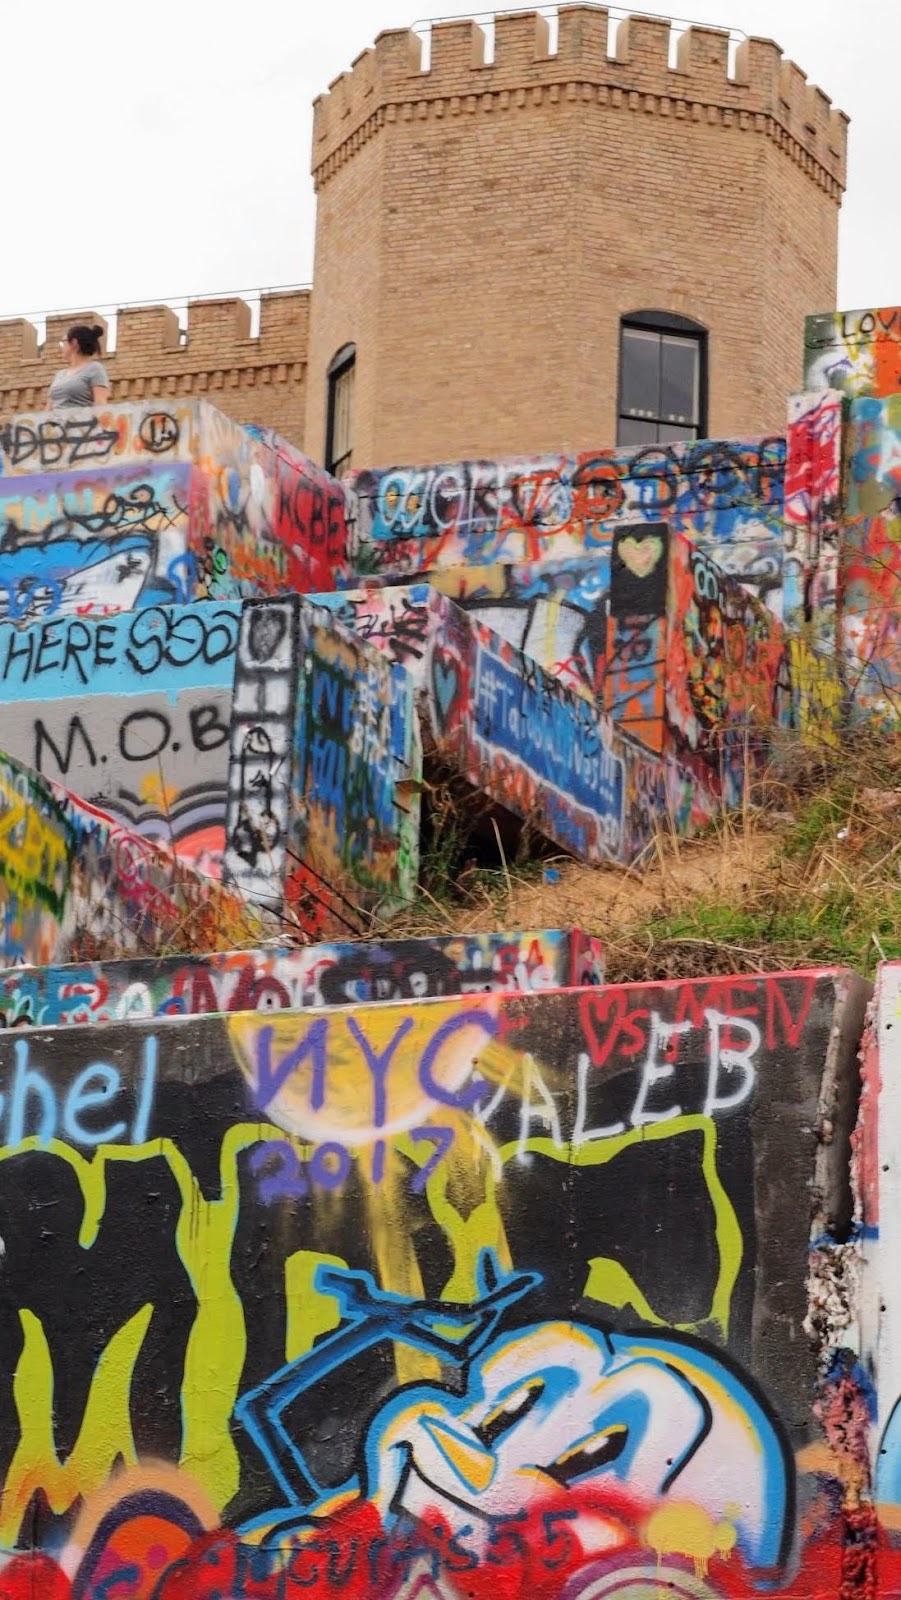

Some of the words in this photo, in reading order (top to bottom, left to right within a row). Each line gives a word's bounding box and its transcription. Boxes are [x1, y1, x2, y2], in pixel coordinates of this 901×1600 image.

[842, 311, 901, 338] LOV
[0, 1035, 158, 1148] hel
[250, 1126, 455, 1206] 2017
